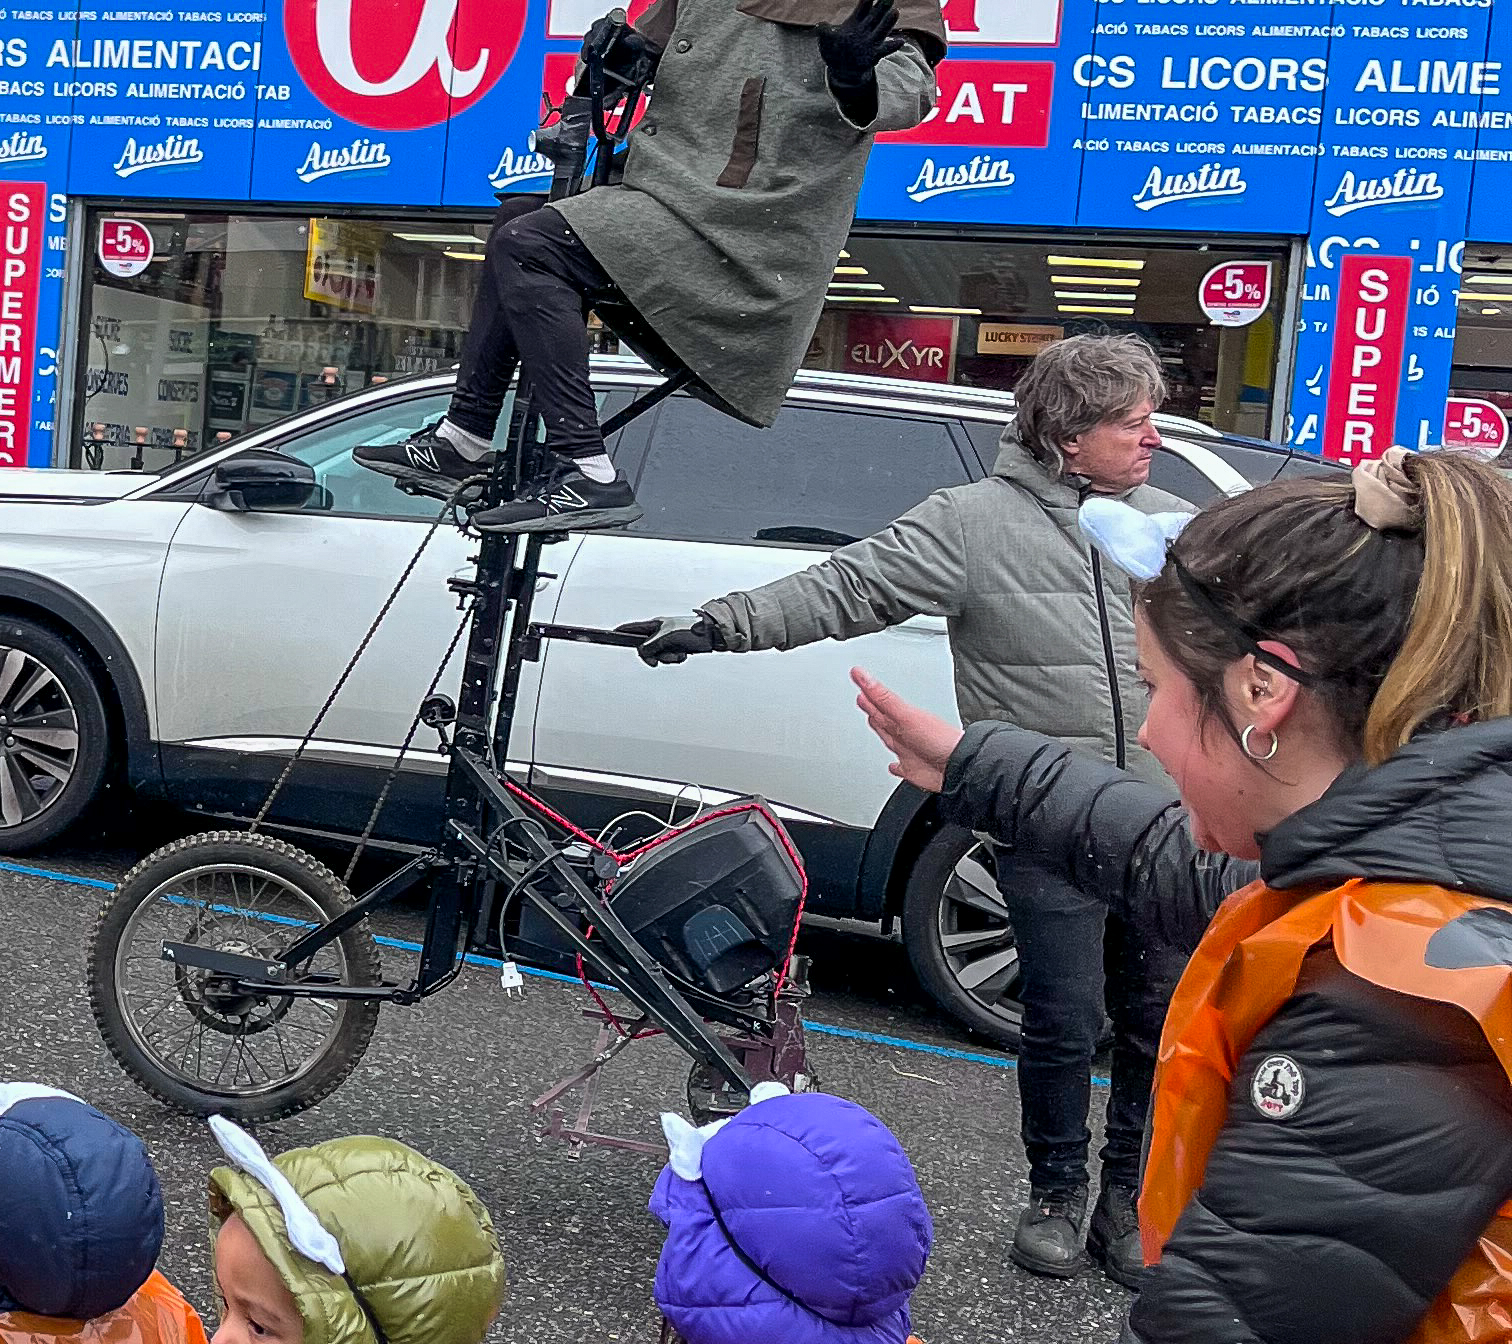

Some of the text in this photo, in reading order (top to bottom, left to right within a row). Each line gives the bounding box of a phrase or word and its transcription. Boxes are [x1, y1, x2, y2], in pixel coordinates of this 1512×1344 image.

[12, 11, 53, 20] TABACS
[102, 10, 173, 21] ALIMENTACIÓ
[178, 12, 221, 22] TABACS
[227, 13, 266, 22] LICORS
[1135, 22, 1468, 38] TABACS LICORS ALIMENTACIÓ TABACS LICORS
[46, 40, 260, 70] ALIMENTACI
[1074, 55, 1501, 94] CS LICORS ALIME
[54, 82, 290, 100] LICORS ALIMENTACIÓ TAB
[0, 114, 41, 124] TABACS
[89, 112, 162, 127] ALIMENTACIÓ
[166, 117, 208, 127] TABACS
[214, 119, 253, 128] LICORS
[258, 118, 332, 129] ALIMENTACIÓ
[1231, 107, 1419, 126] TABACS LICORS
[114, 135, 204, 178] Austin
[296, 139, 391, 183] Austin
[1116, 141, 1169, 152] TABACS
[1176, 143, 1225, 153] LICORS
[1333, 146, 1388, 158] TABACS
[1396, 148, 1447, 159] LICORS
[906, 155, 1015, 203] Austin
[1132, 162, 1247, 212] Austin
[1324, 167, 1444, 217] Austin
[105, 225, 146, 254] -5%
[1210, 268, 1262, 300] -5%
[985, 331, 1019, 343] LUCKY
[851, 338, 944, 370] ELIXYR
[1338, 268, 1390, 466] SUPER
[1448, 406, 1498, 440] -5%
